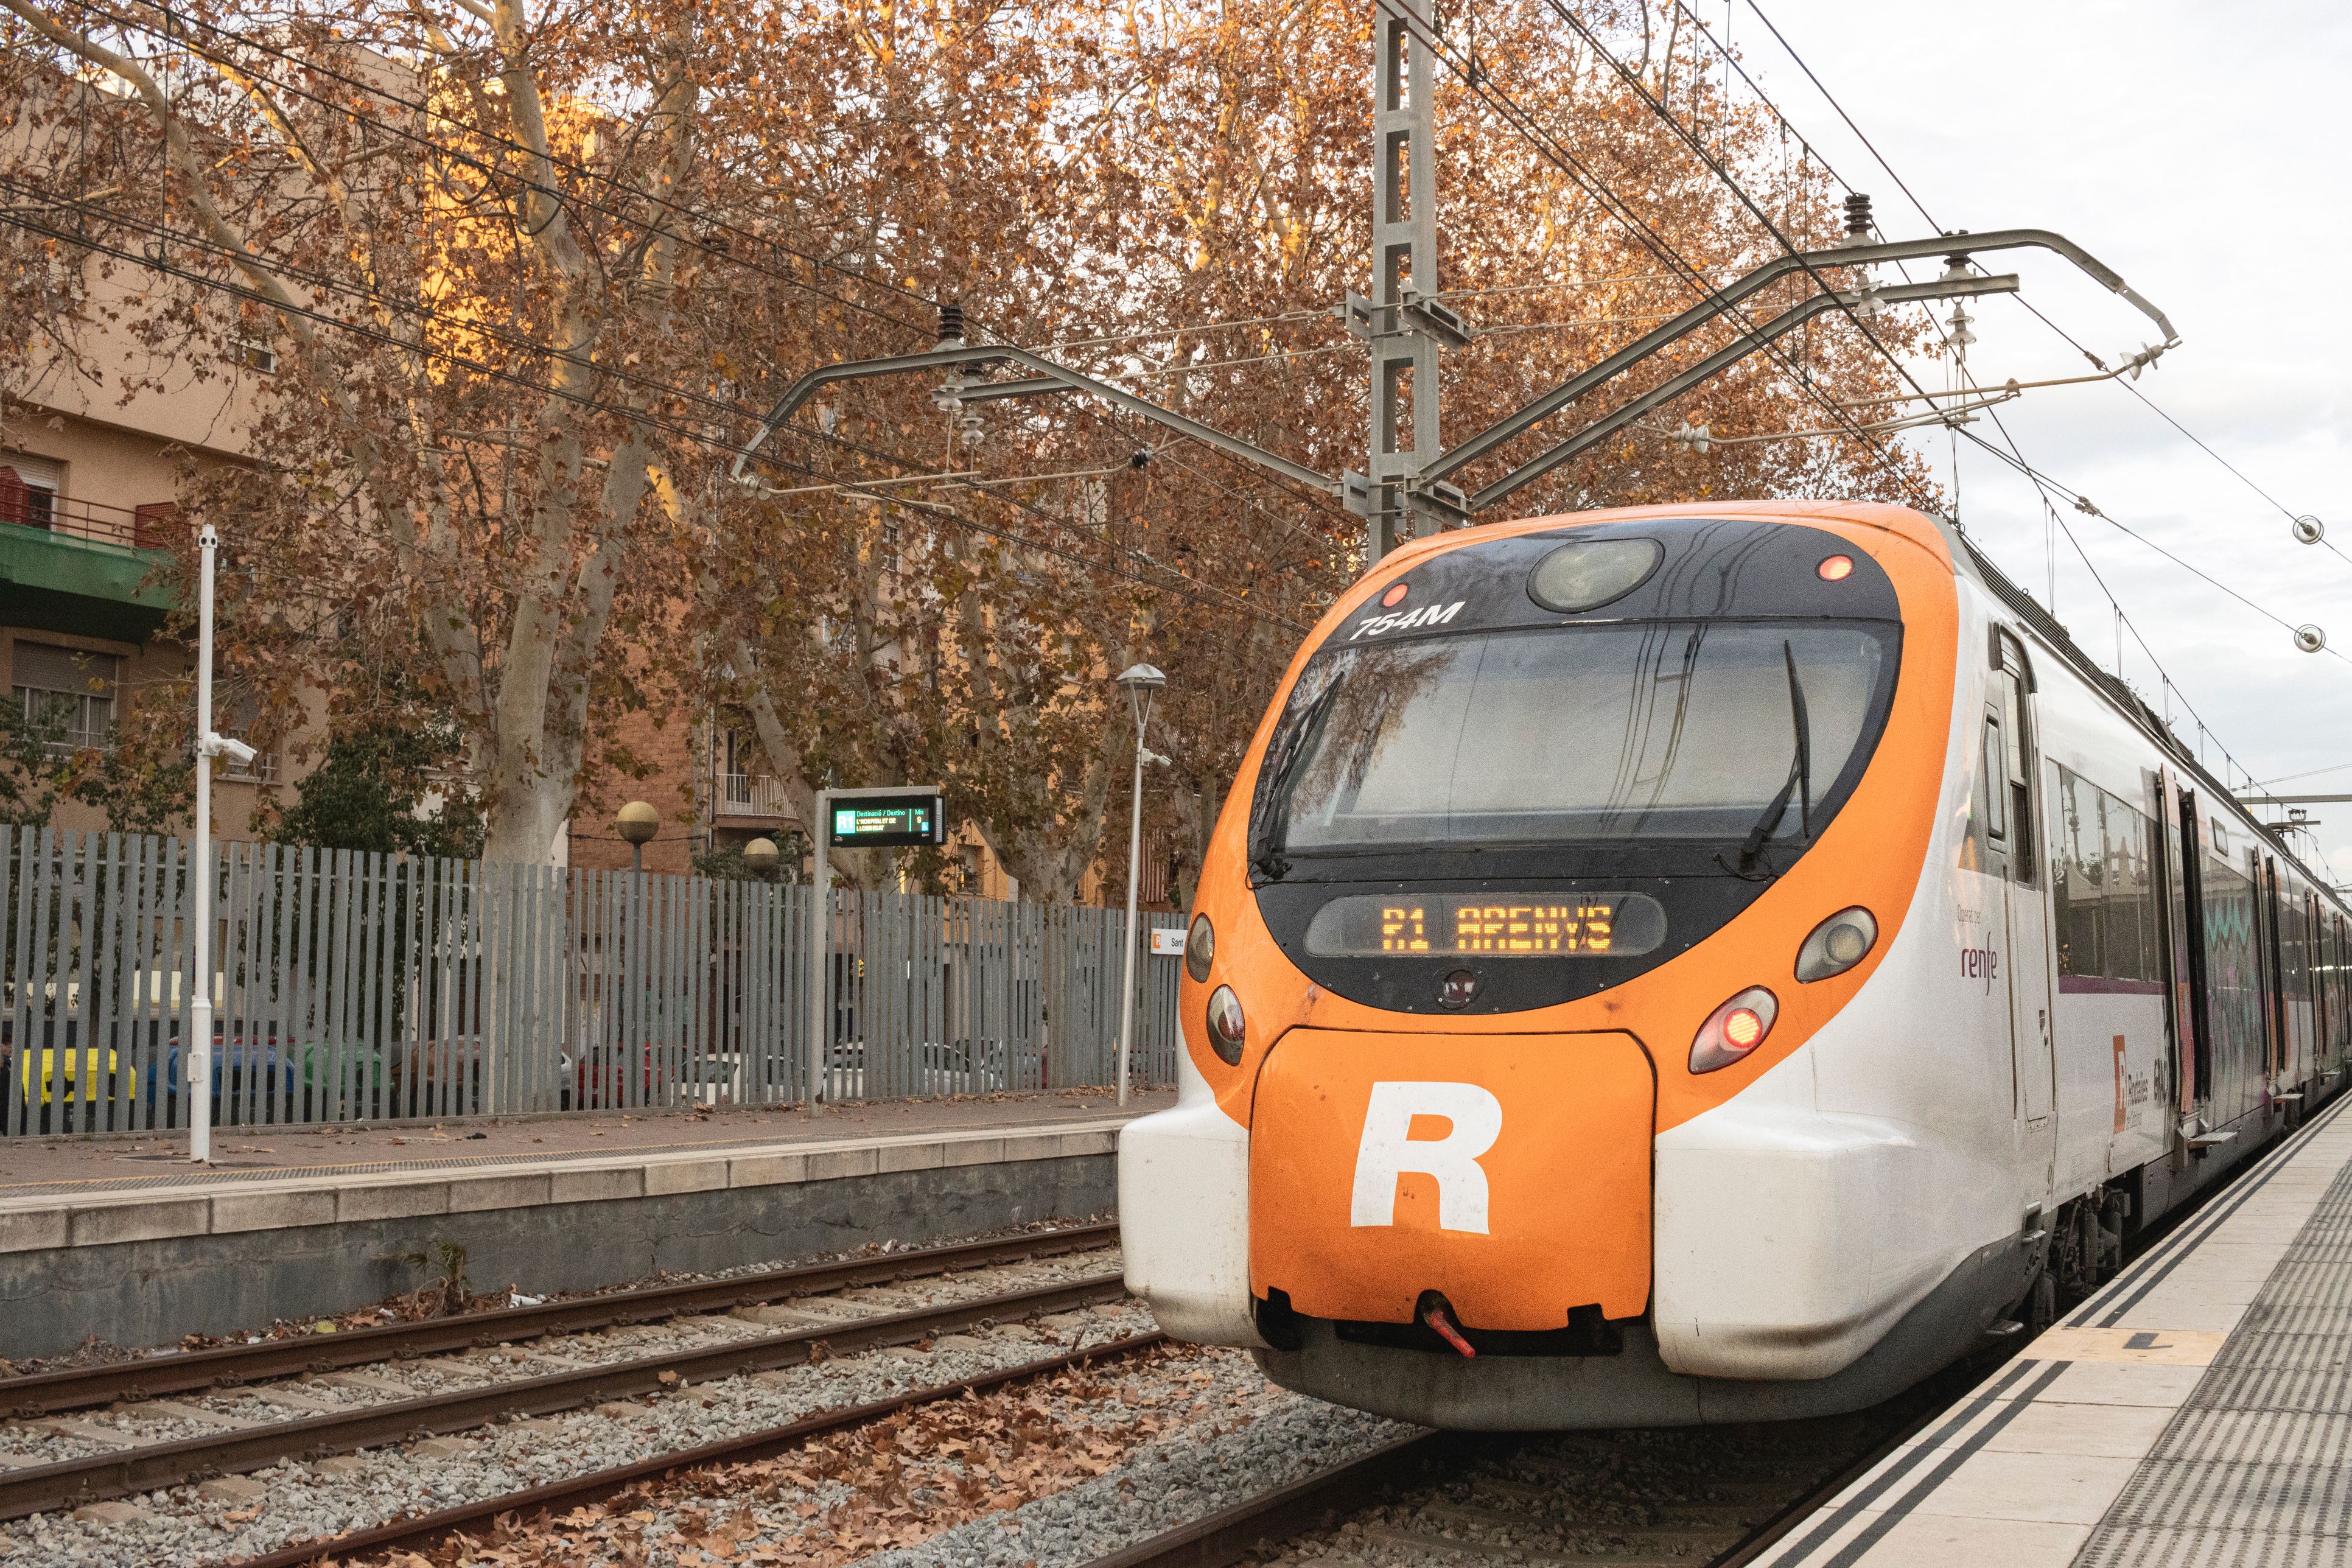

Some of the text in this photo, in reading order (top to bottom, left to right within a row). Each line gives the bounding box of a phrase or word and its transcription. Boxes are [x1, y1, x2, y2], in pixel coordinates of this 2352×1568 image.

[1349, 601, 1466, 641] 754M
[837, 816, 853, 829] R1
[1171, 937, 1183, 947] Sant
[1383, 906, 1611, 950] R1 ARENYS
[1961, 931, 1997, 996] renfe
[1351, 1081, 1502, 1235] R
